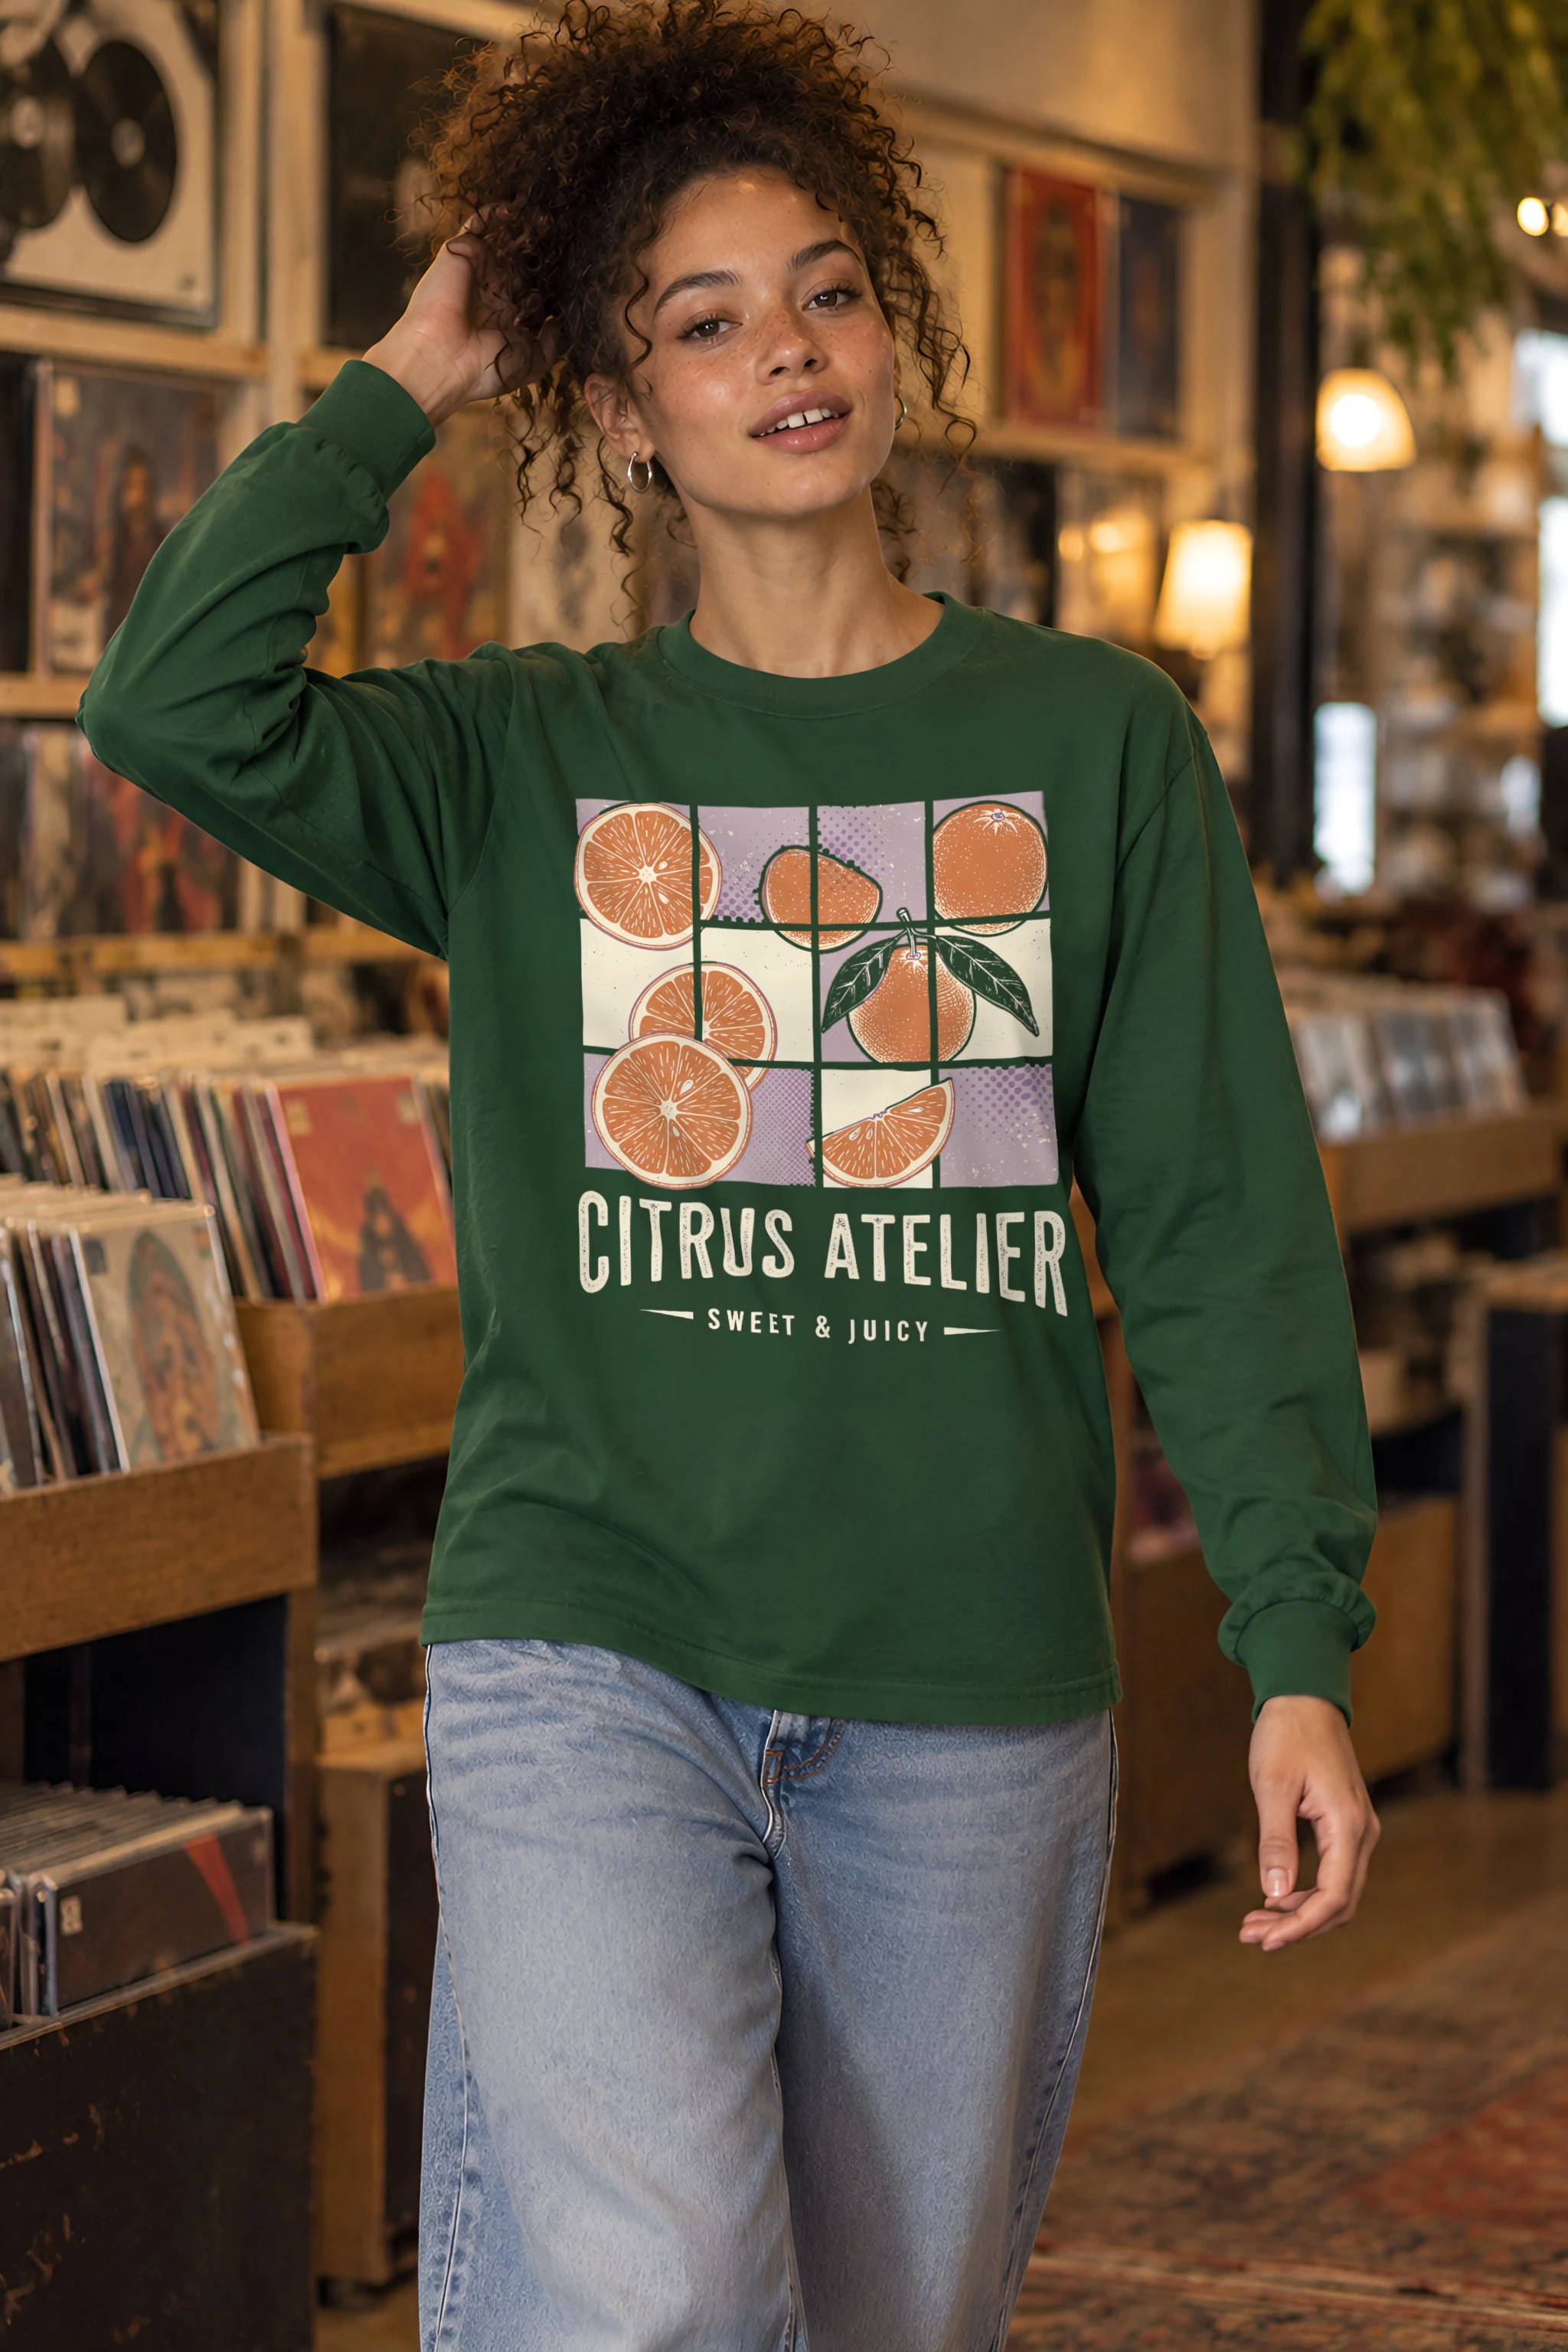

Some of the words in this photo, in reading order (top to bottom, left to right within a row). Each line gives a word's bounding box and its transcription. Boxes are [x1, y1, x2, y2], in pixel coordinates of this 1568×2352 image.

[578, 1190, 795, 1294] CITRUS
[824, 1210, 1068, 1317] ATELIER
[707, 1308, 795, 1336] SWEET
[815, 1315, 831, 1338] &
[848, 1318, 928, 1344] JUICY
